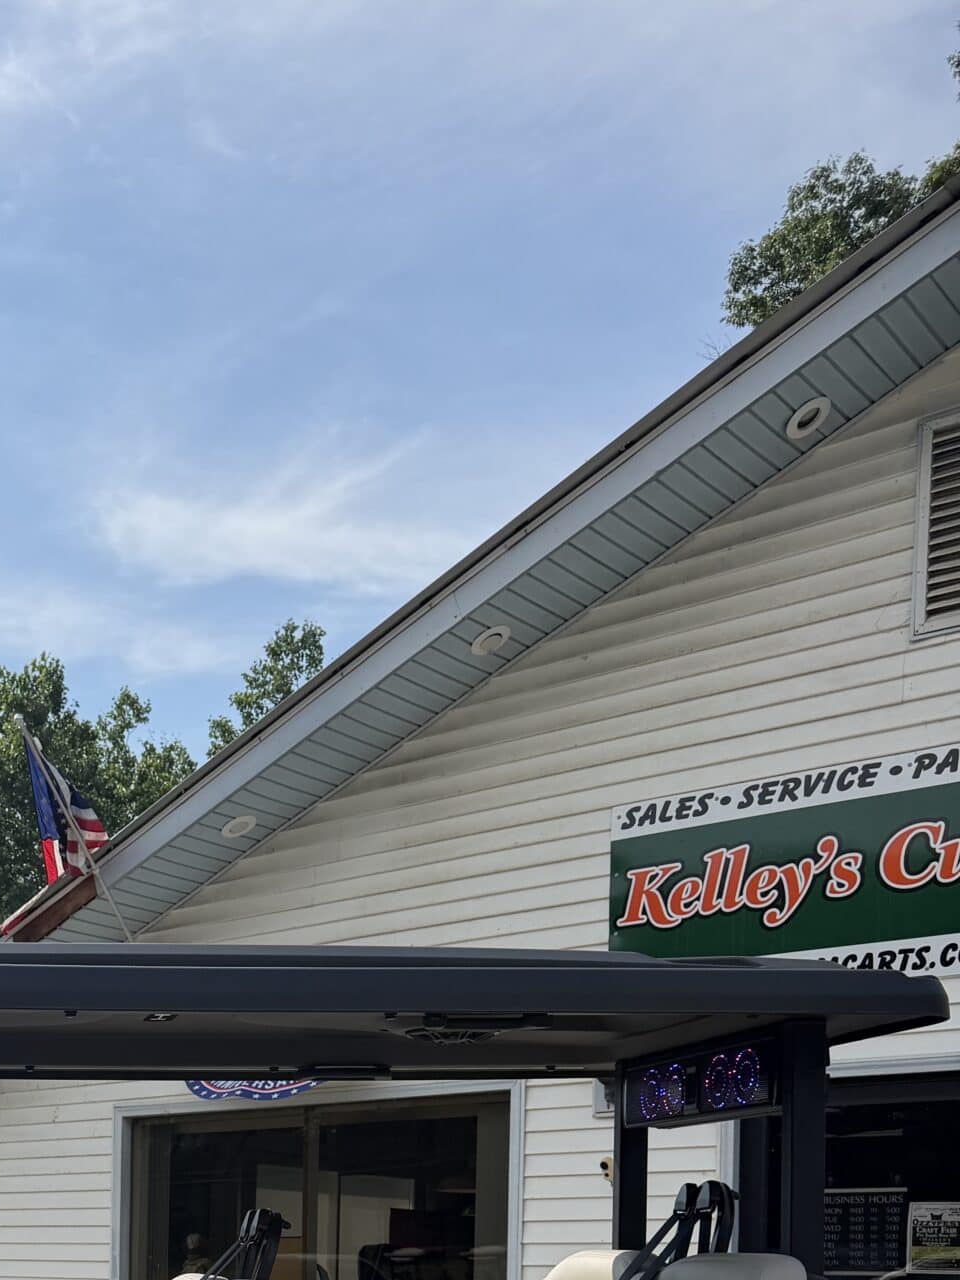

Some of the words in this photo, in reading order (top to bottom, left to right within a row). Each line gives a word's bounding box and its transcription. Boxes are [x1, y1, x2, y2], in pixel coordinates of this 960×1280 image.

[620, 792, 715, 830] SALES
[737, 762, 882, 809] SERVICE
[616, 835, 863, 929] Kelley's
[823, 1195, 865, 1204] BUSINESS
[868, 1194, 904, 1204] HOURS
